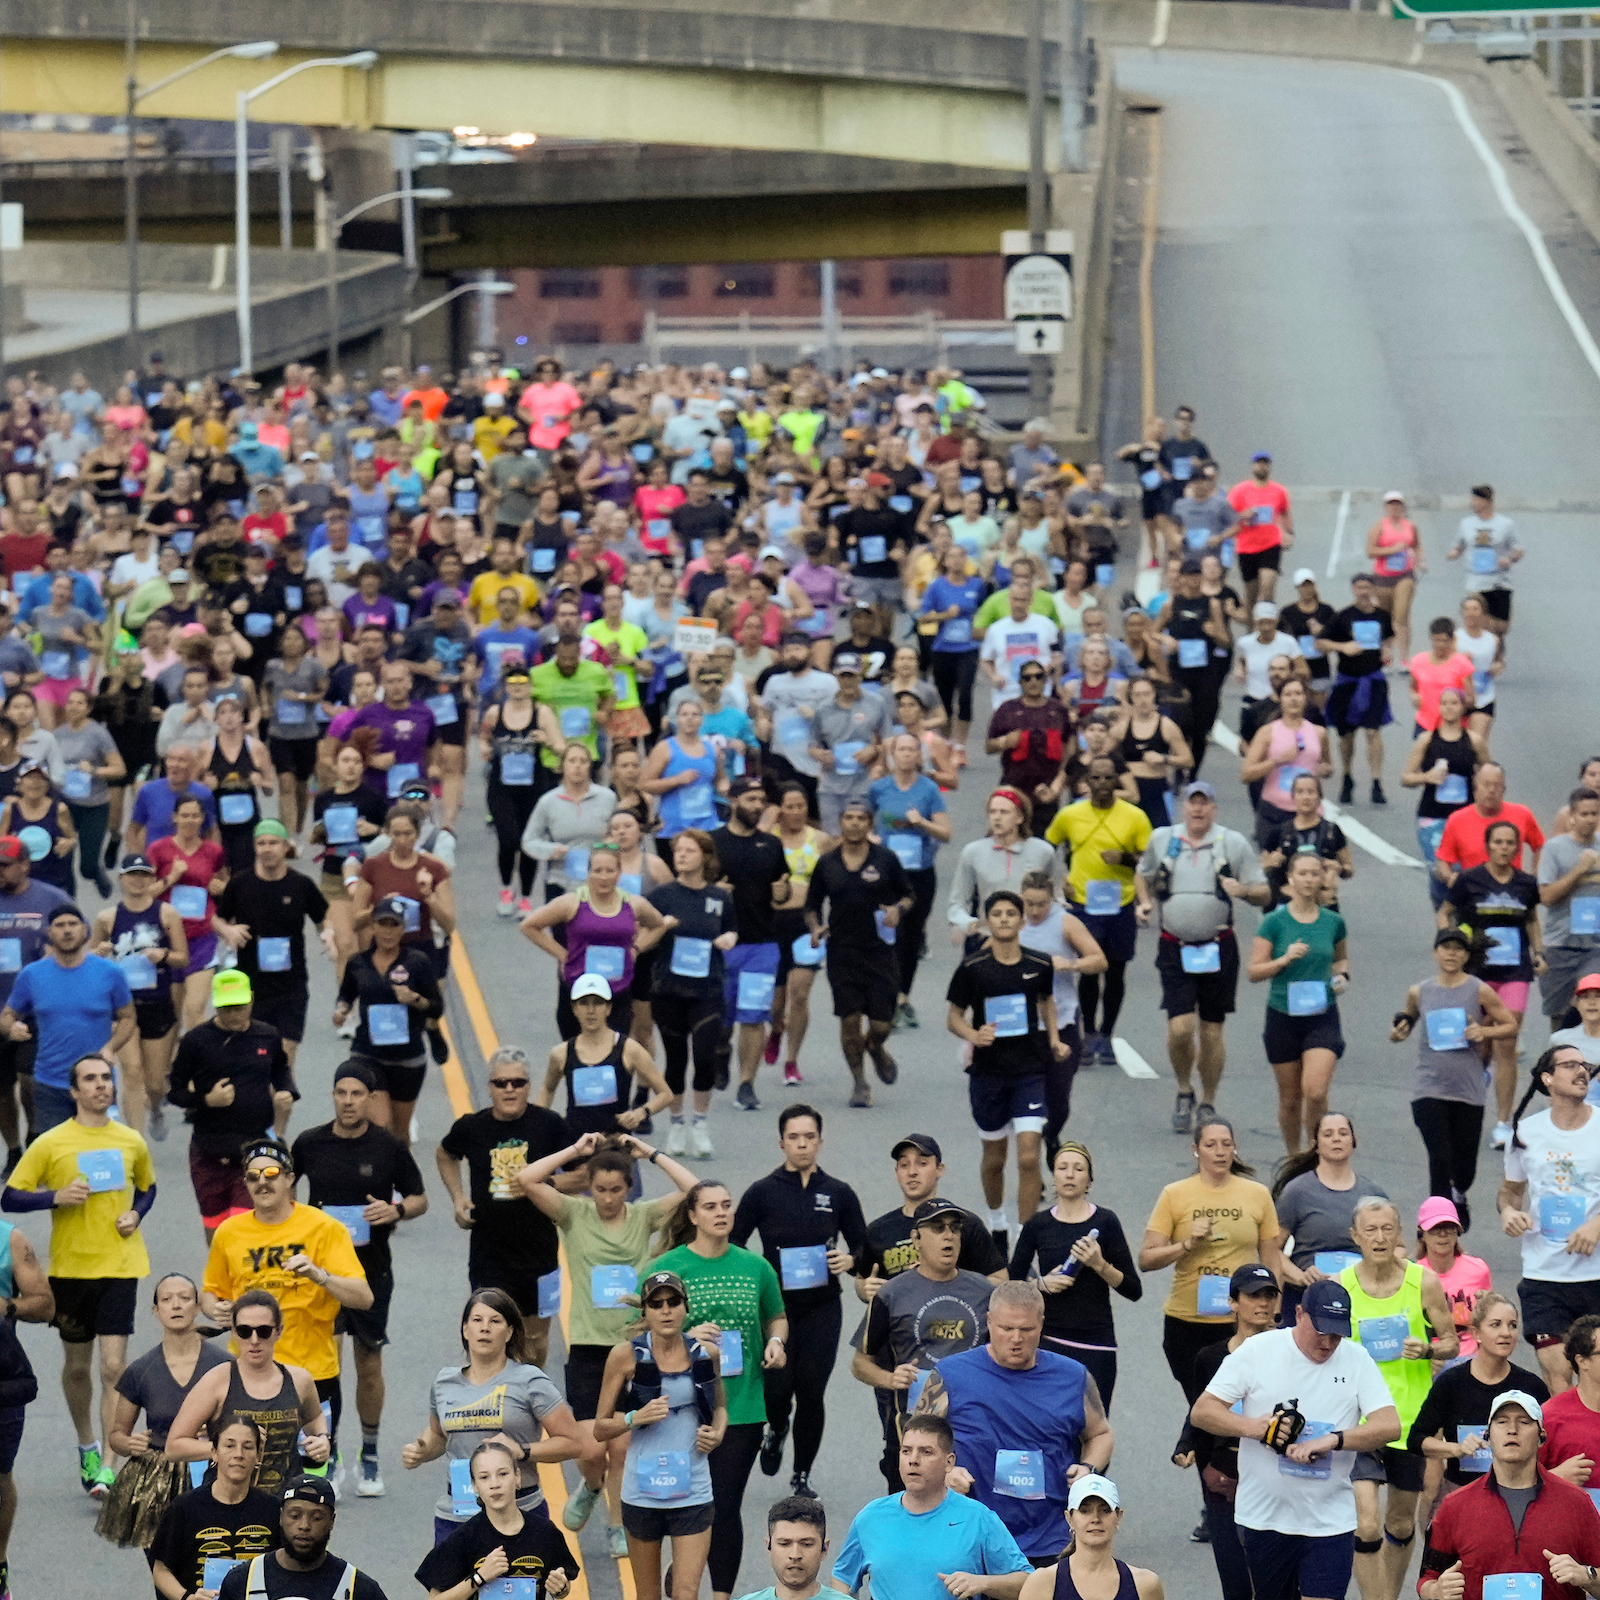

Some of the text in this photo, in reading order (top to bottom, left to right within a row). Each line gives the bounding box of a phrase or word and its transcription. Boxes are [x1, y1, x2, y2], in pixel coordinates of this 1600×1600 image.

[1192, 1207, 1243, 1223] pierogi
[1197, 1265, 1230, 1277] race
[1372, 1339, 1398, 1350] 1366
[444, 1408, 500, 1419] PITTSBURGH
[649, 1476, 676, 1486] 1420
[1008, 1475, 1035, 1486] 1002
